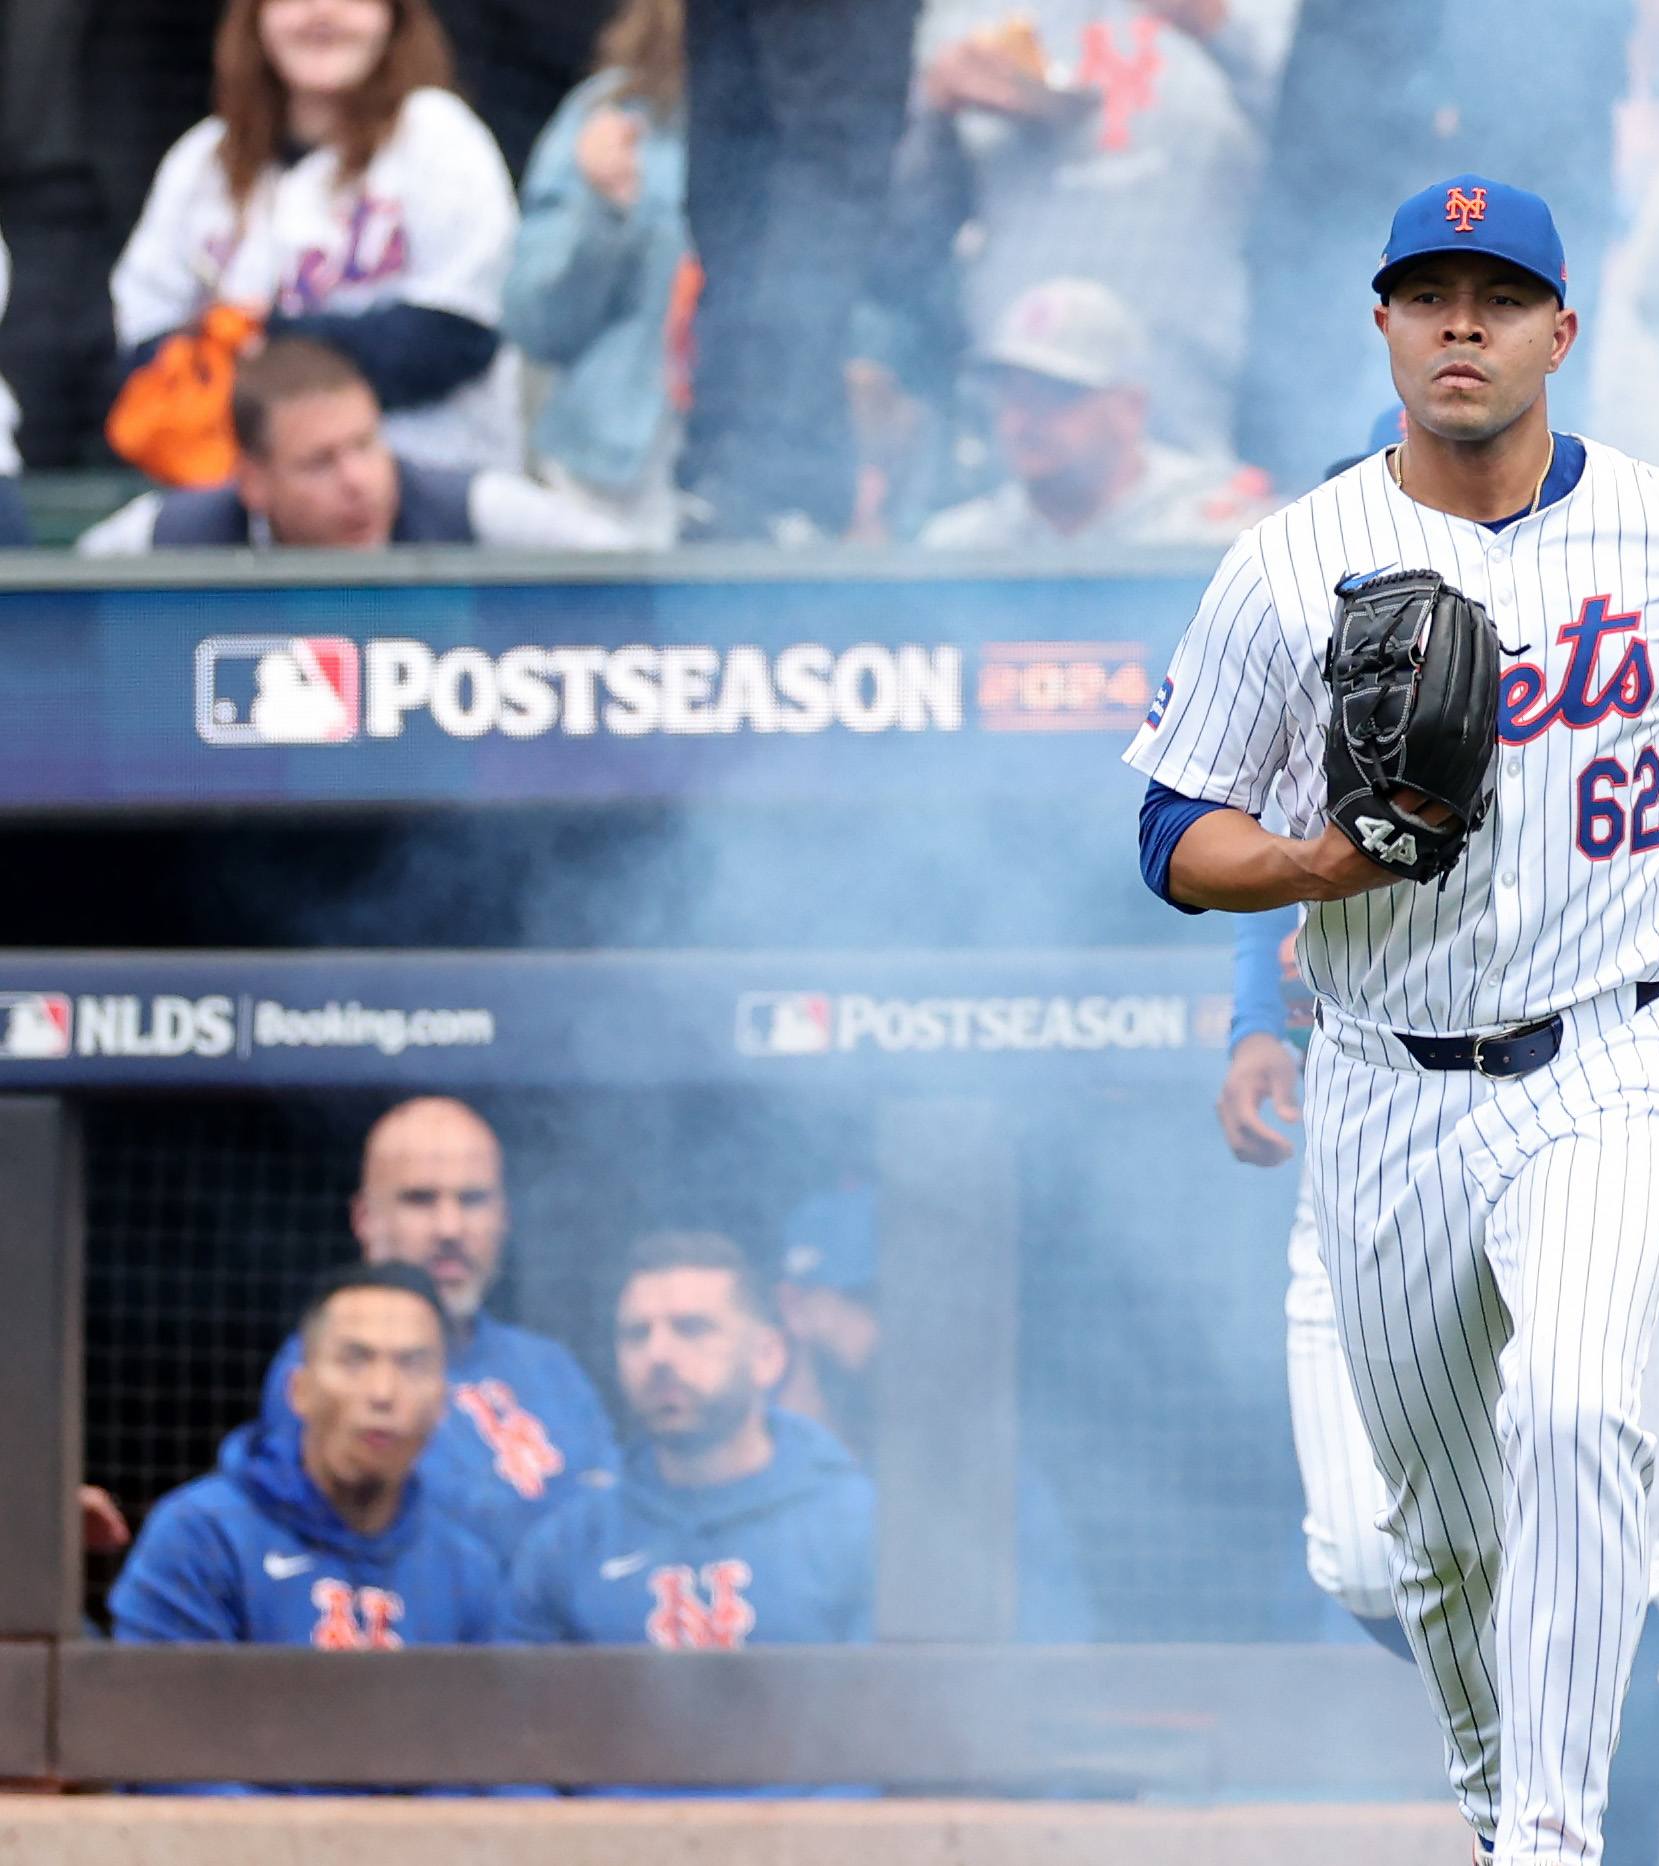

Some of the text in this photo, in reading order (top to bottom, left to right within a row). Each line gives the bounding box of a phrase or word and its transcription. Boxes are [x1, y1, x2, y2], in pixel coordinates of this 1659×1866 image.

[364, 637, 963, 738] POSTSEASON
[1494, 593, 1655, 747] ets
[76, 996, 495, 1057] NLDS Booking.com
[837, 994, 1187, 1051] POSTSEASON
